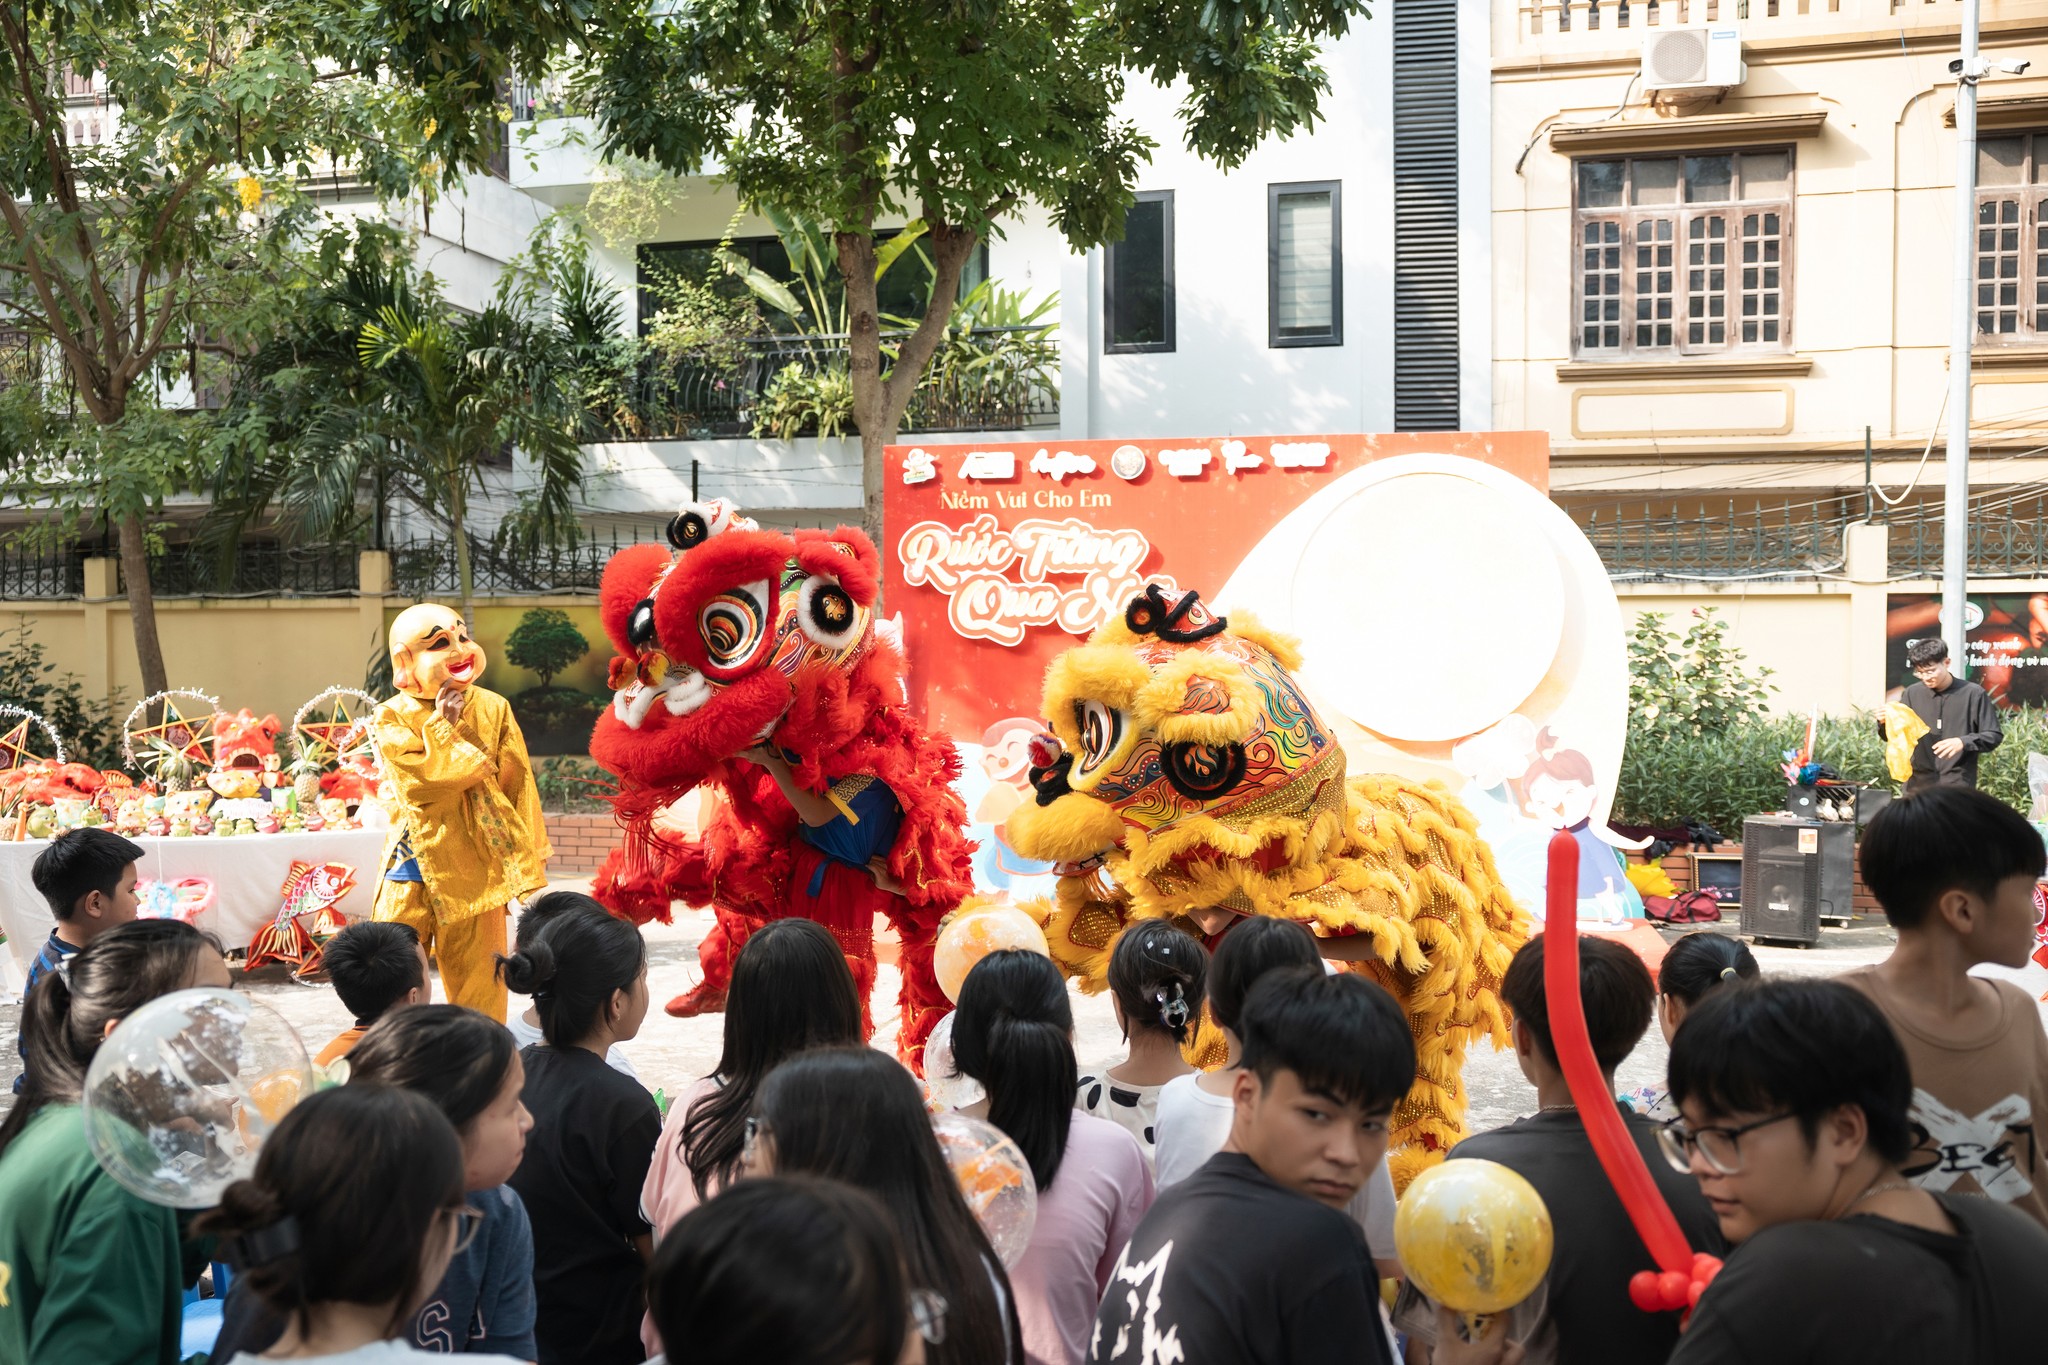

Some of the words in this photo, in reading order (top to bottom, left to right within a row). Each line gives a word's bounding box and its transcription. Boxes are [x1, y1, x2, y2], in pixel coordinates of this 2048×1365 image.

[996, 490, 1028, 508] Vui
[1034, 490, 1073, 508] Cho
[1080, 489, 1112, 507] Em
[955, 577, 1059, 639] Qua
